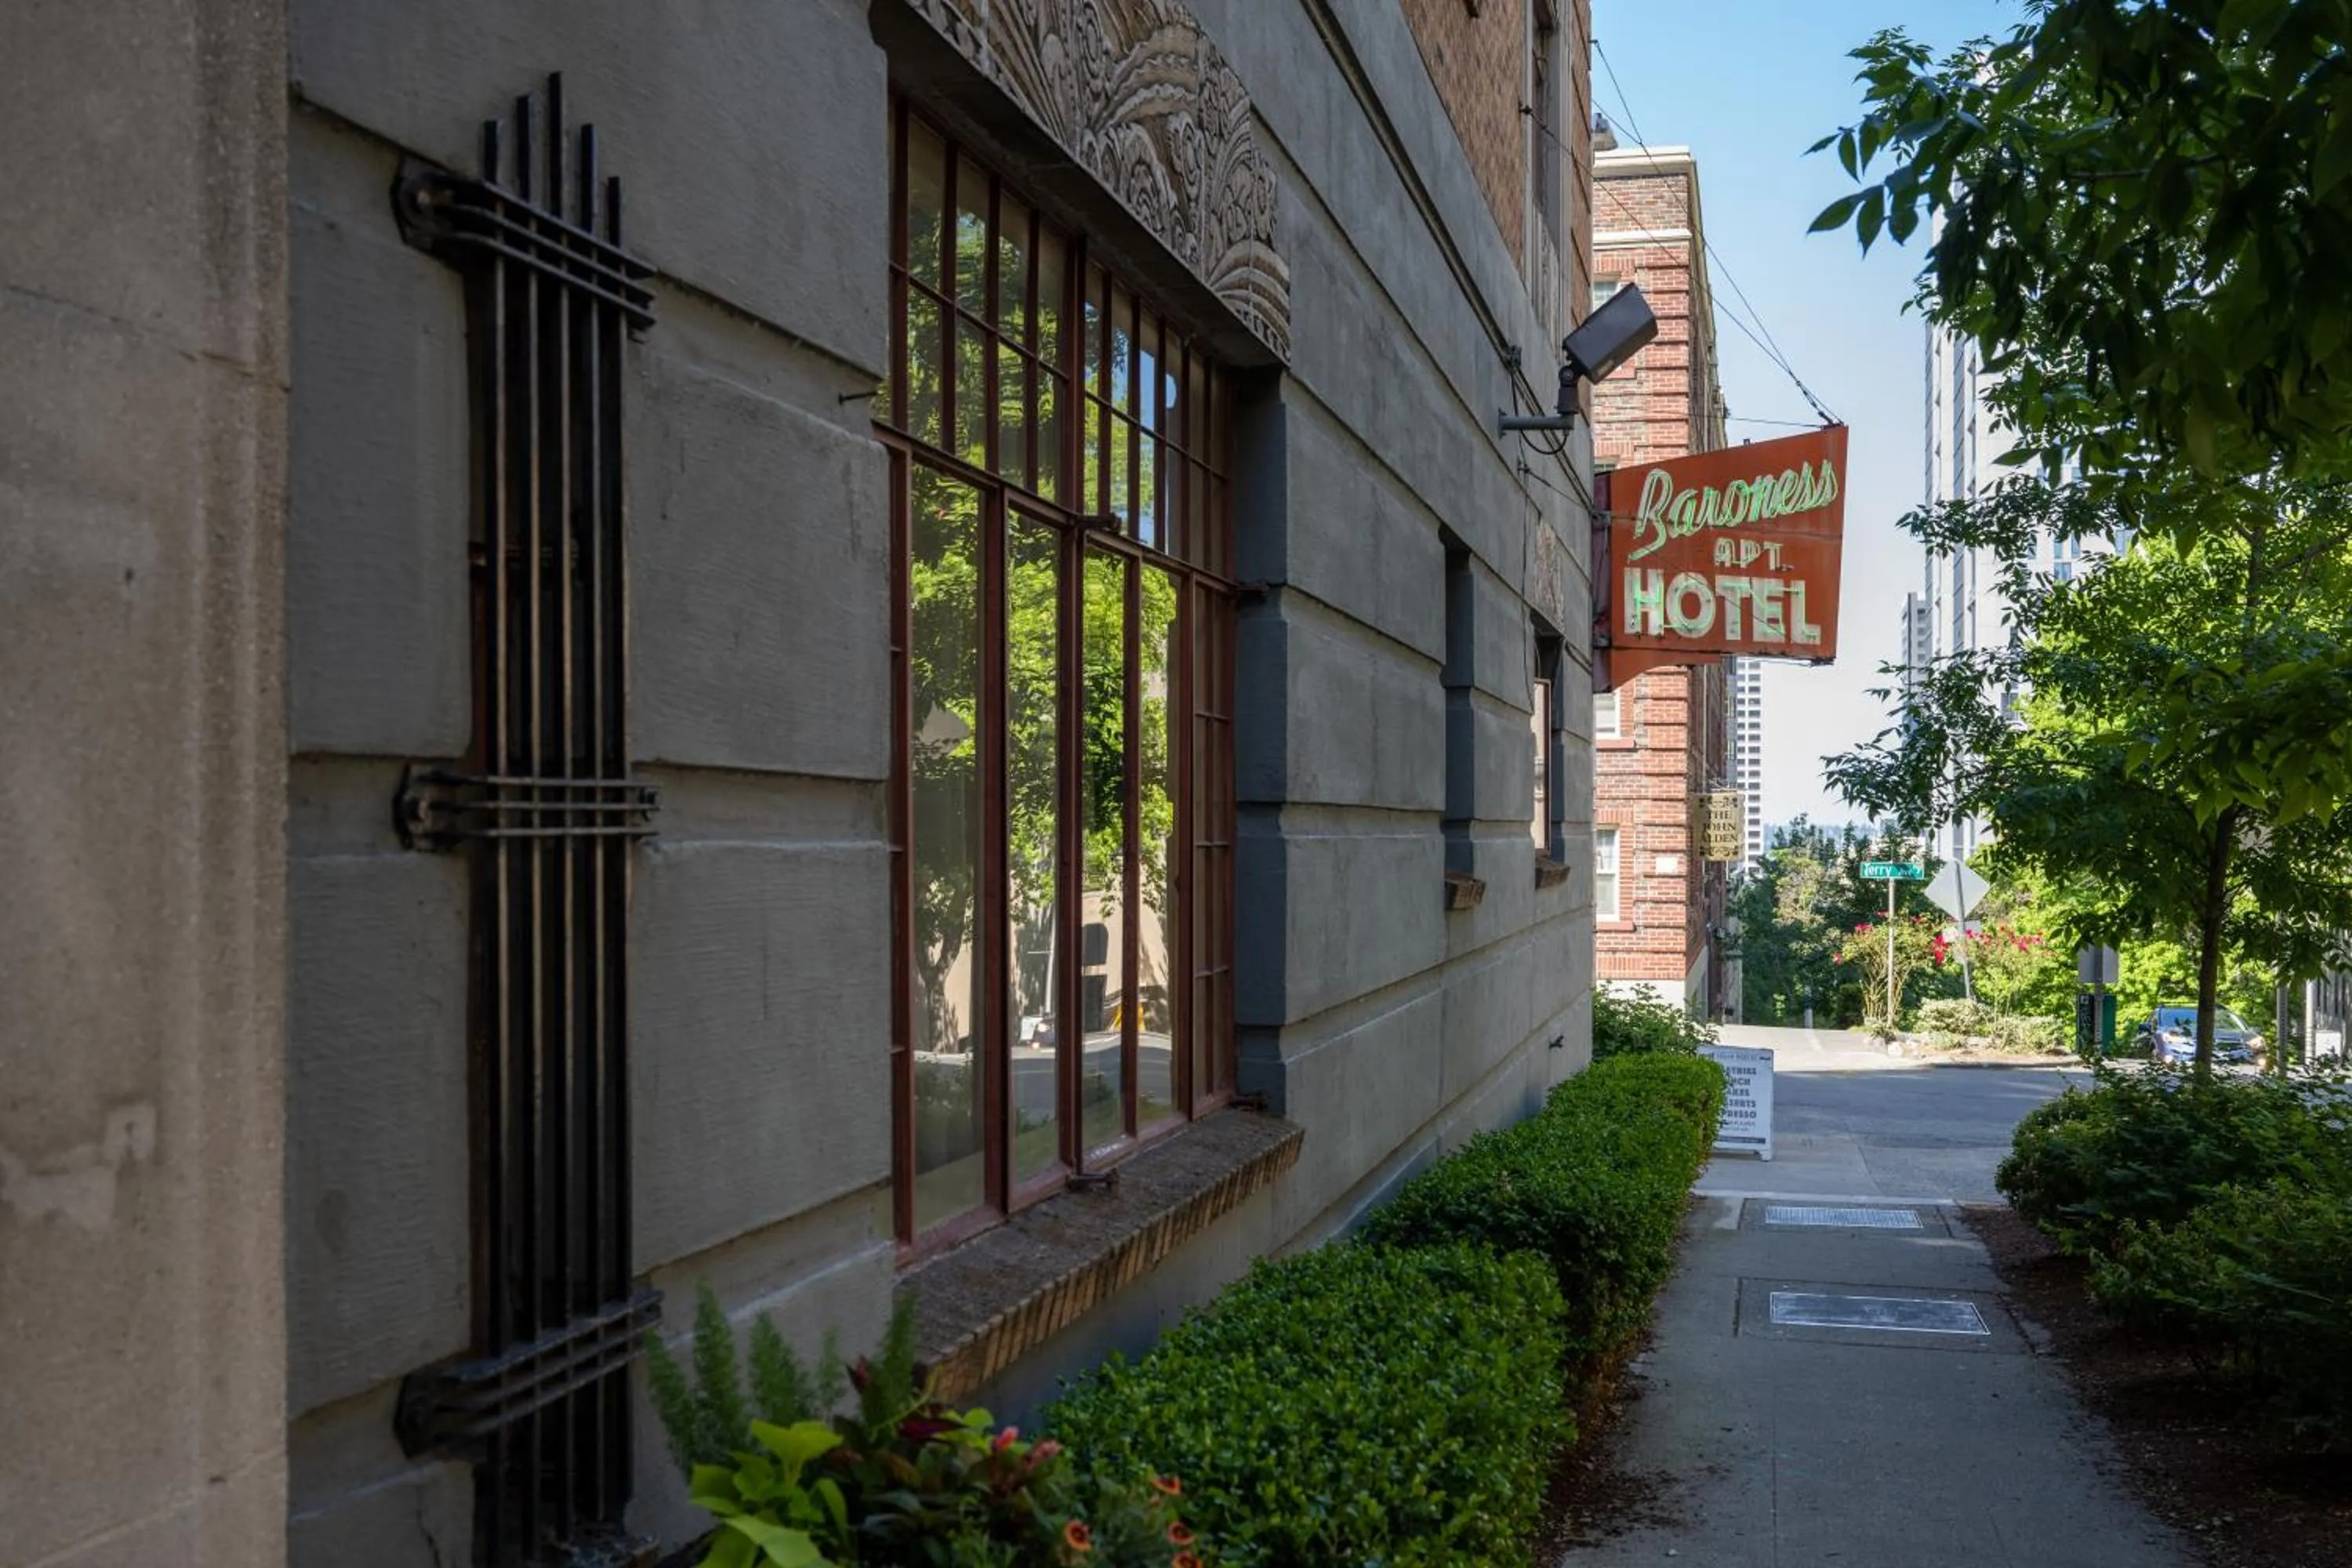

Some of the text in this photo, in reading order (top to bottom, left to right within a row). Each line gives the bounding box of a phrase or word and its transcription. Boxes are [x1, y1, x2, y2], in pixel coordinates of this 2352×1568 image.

[1627, 459, 1838, 562] Baroness
[1624, 567, 1821, 645] HOTEL
[1864, 863, 1892, 878] Terry
[1721, 1109, 1757, 1119] PRESSO
